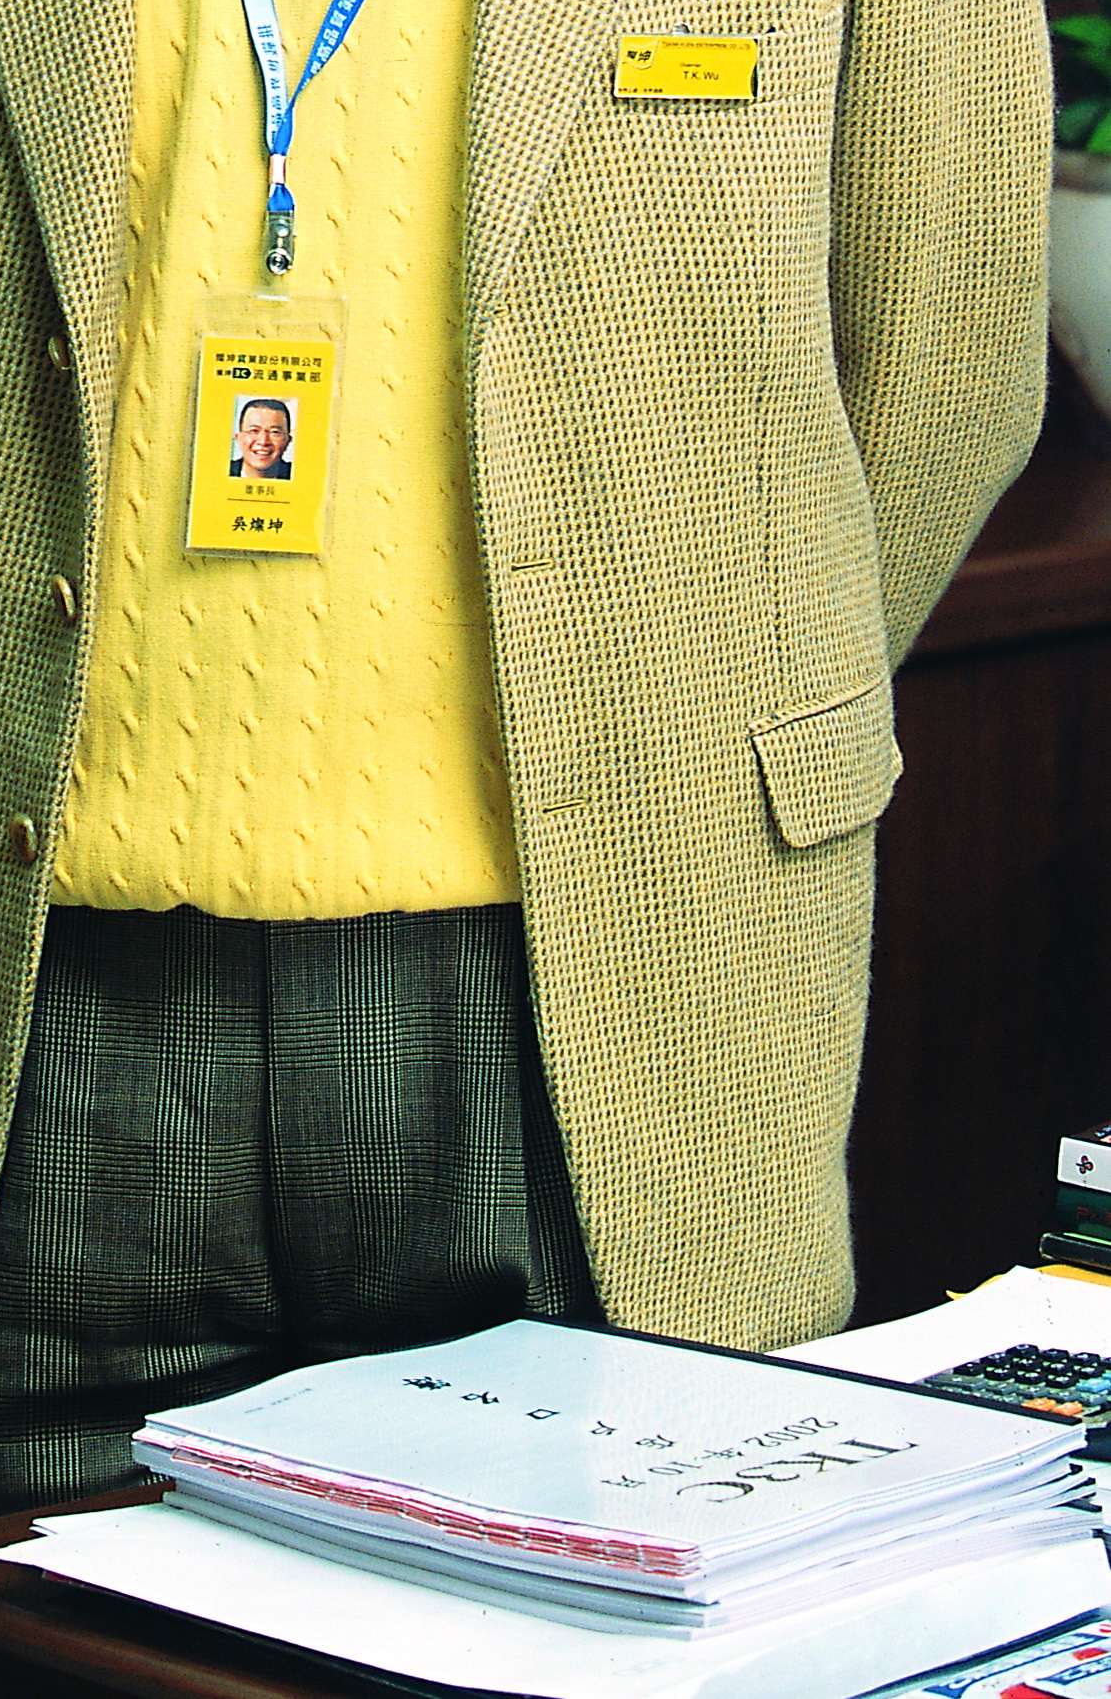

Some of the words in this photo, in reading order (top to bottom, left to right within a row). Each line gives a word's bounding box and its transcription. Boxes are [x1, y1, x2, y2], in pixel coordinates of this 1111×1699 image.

[703, 71, 719, 81] Wu
[231, 515, 284, 534] 吳燦坤
[676, 1438, 920, 1502] TK3C
